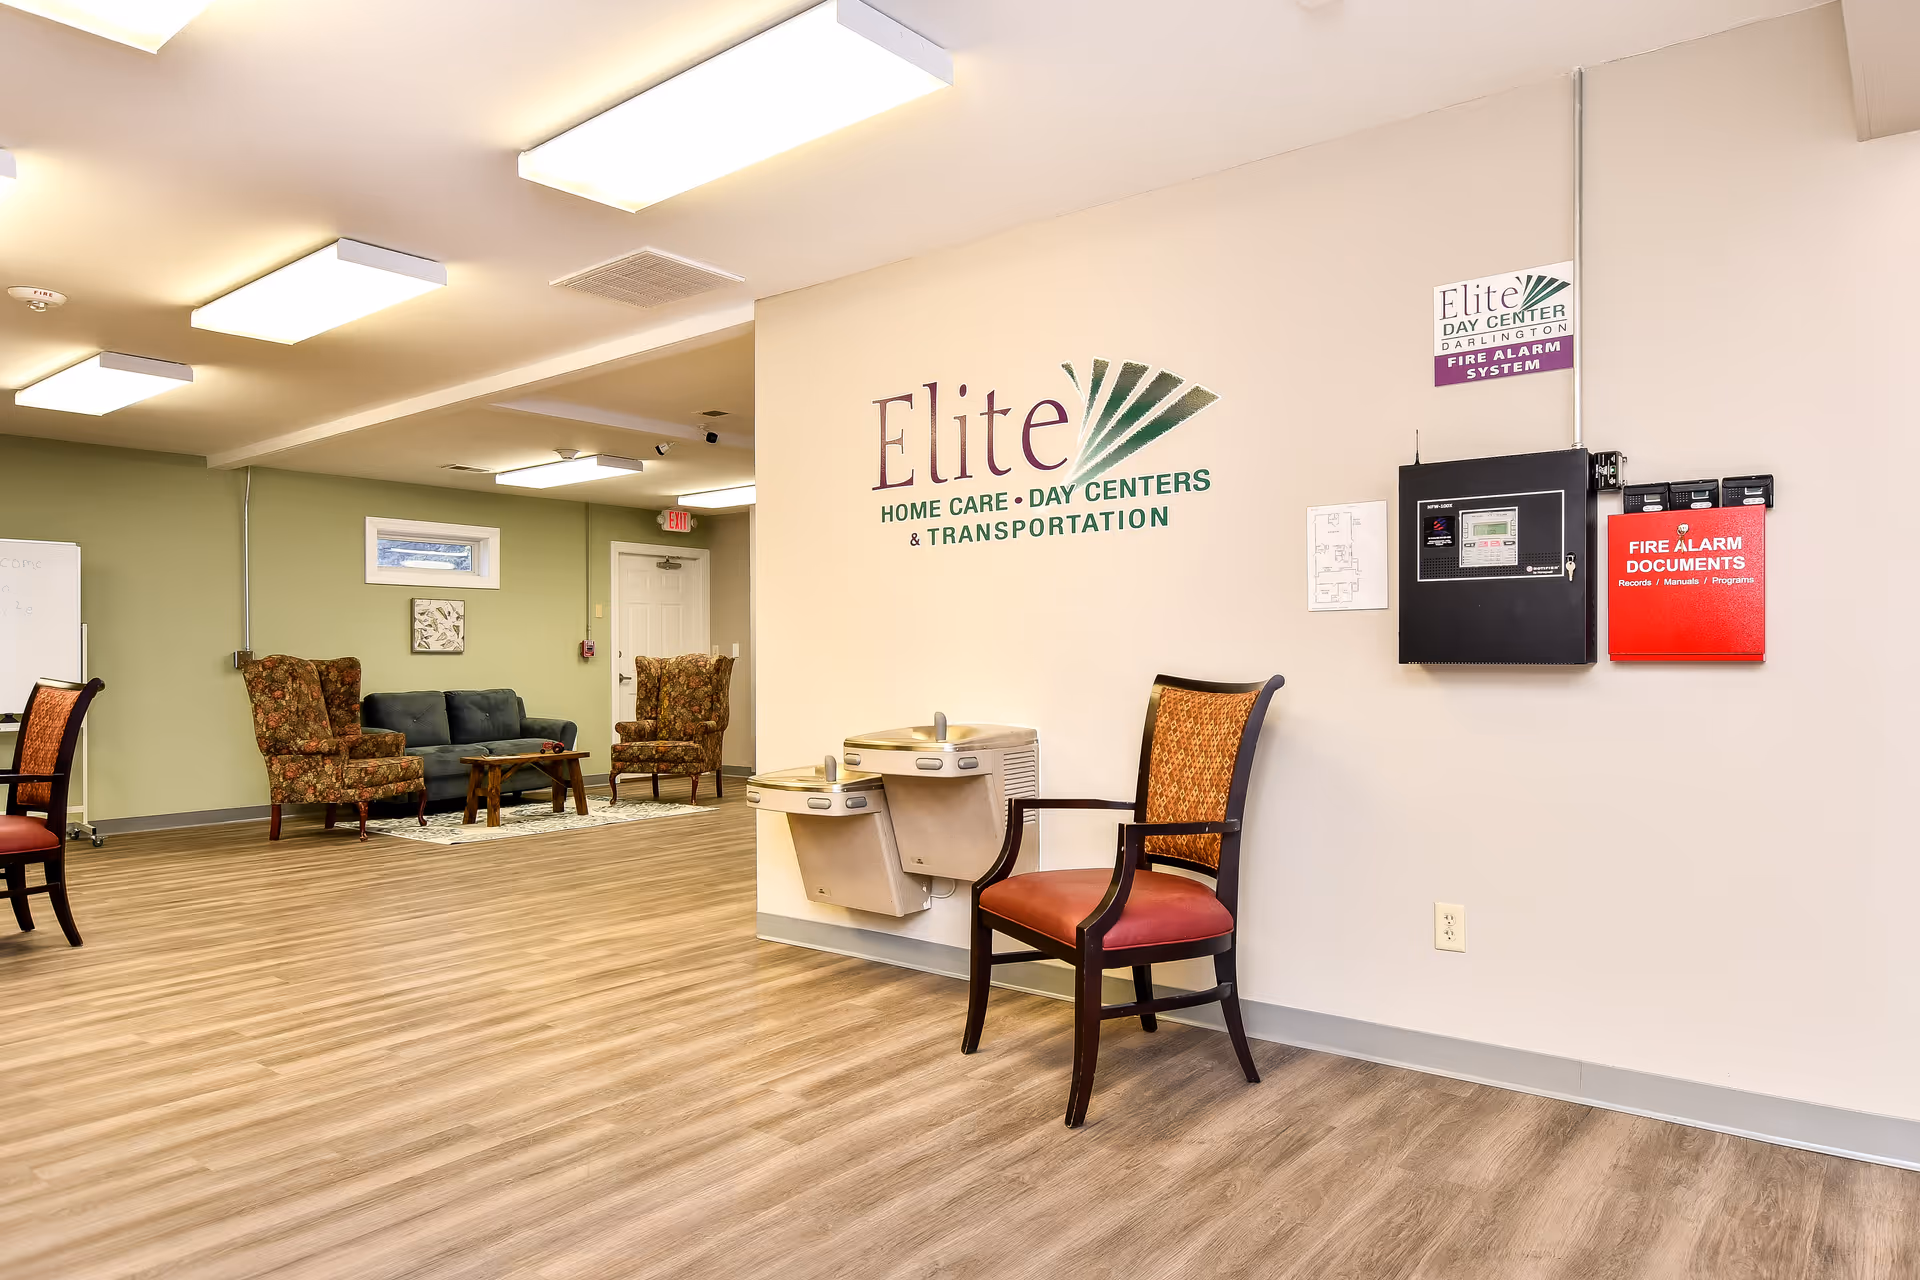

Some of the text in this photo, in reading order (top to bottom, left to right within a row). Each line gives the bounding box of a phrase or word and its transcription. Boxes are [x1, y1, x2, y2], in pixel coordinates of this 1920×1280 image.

[33, 290, 53, 298] FIRE
[1439, 284, 1519, 320] Elite
[1443, 304, 1565, 336] DAY CENTER
[1442, 323, 1567, 351] DARLINGTON
[1447, 341, 1561, 368] FIRE ALARM
[1467, 359, 1540, 379] SYSTEM
[872, 381, 1069, 491] Elite
[881, 468, 1211, 523] HOME CARE DAY CENTERS
[669, 511, 688, 530] EXIT
[910, 506, 1169, 547] & TRANSPORTATION
[1629, 536, 1742, 555] FIRE ALARM
[1626, 556, 1746, 573] DOCUMENTS
[1618, 579, 1652, 587] Records
[1663, 577, 1699, 586] Manuals
[1712, 576, 1754, 586] Programs
